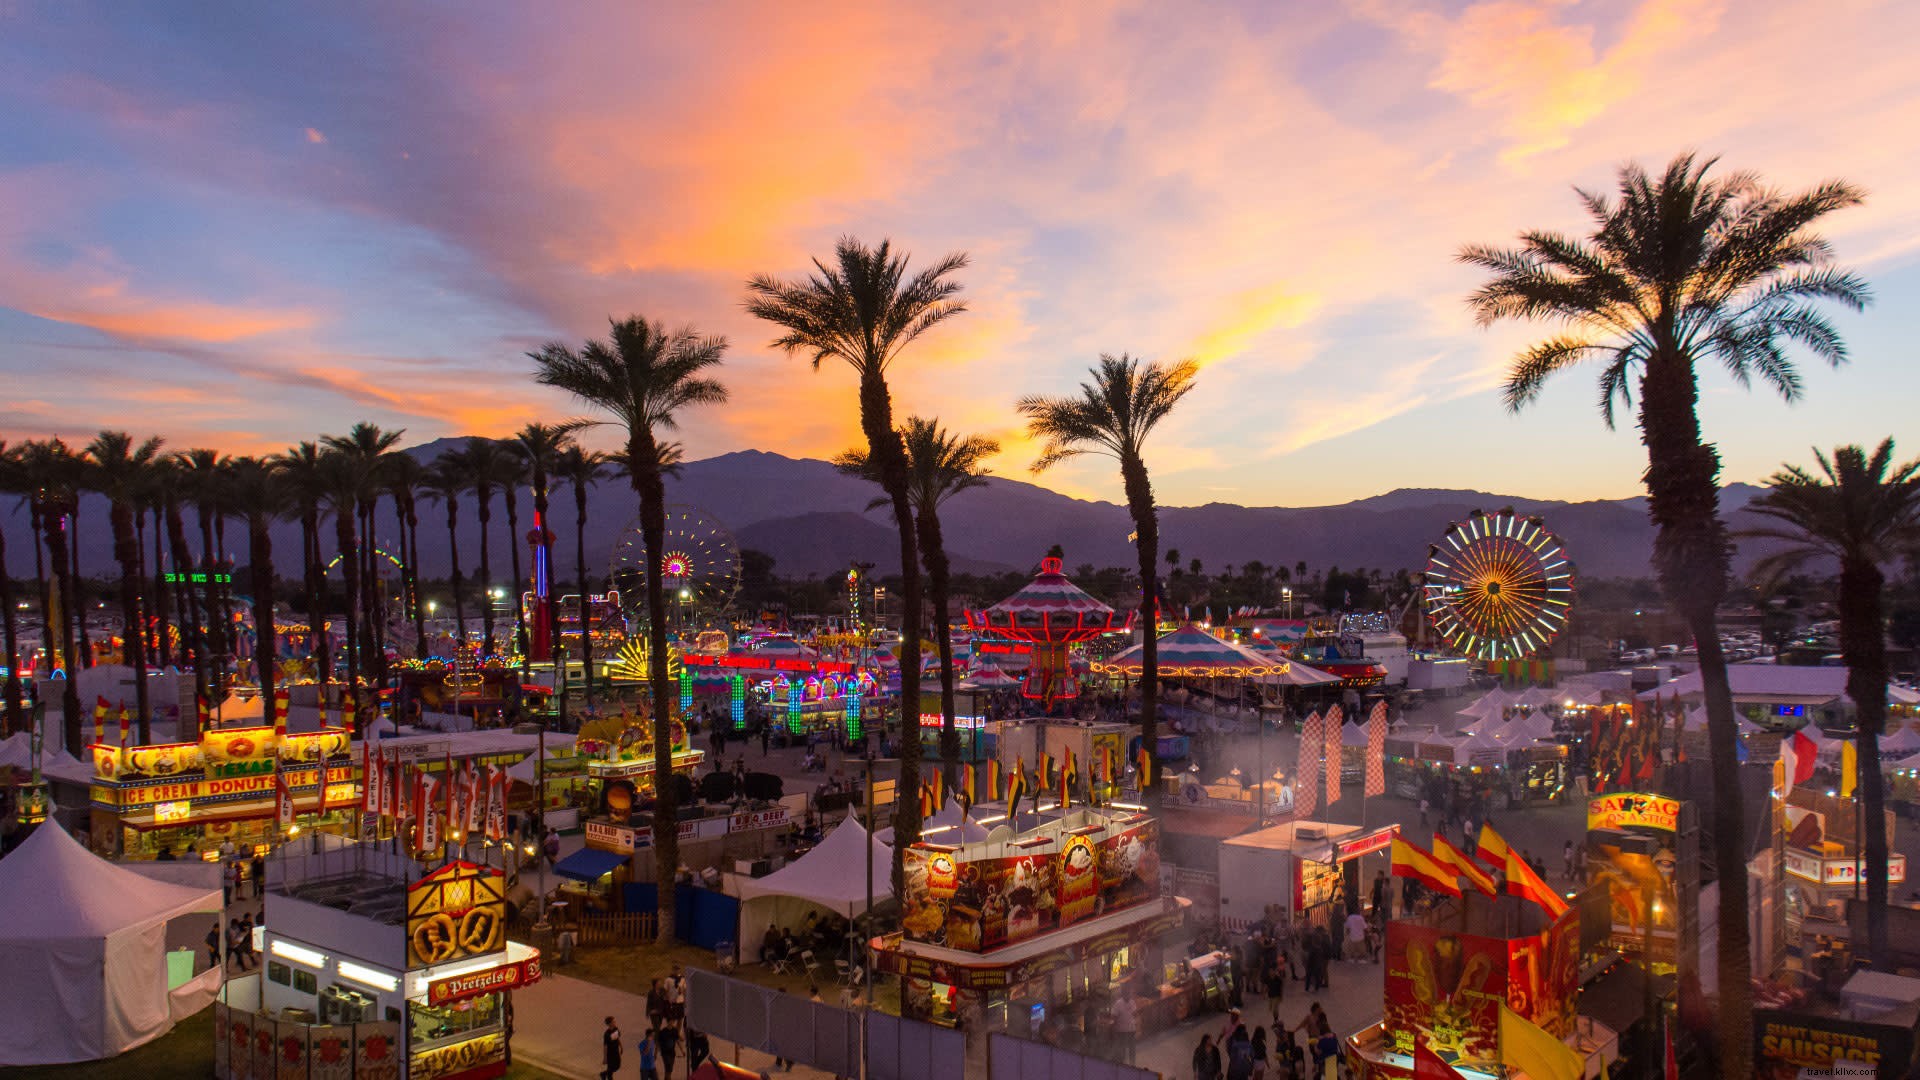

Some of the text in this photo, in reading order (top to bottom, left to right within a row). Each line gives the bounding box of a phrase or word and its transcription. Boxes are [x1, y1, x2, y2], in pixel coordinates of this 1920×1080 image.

[215, 759, 274, 777] TEXAS
[285, 766, 352, 786] ICE CEAM
[122, 788, 145, 804] ICE
[152, 782, 199, 800] CREAM
[209, 775, 276, 795] DONUTS
[763, 810, 785, 821] BEEF
[1608, 813, 1625, 822] ON
[450, 971, 504, 996] Pretzels
[1766, 1023, 1878, 1049] GIANT WESTERN
[1762, 1035, 1881, 1066] SAUSAGE
